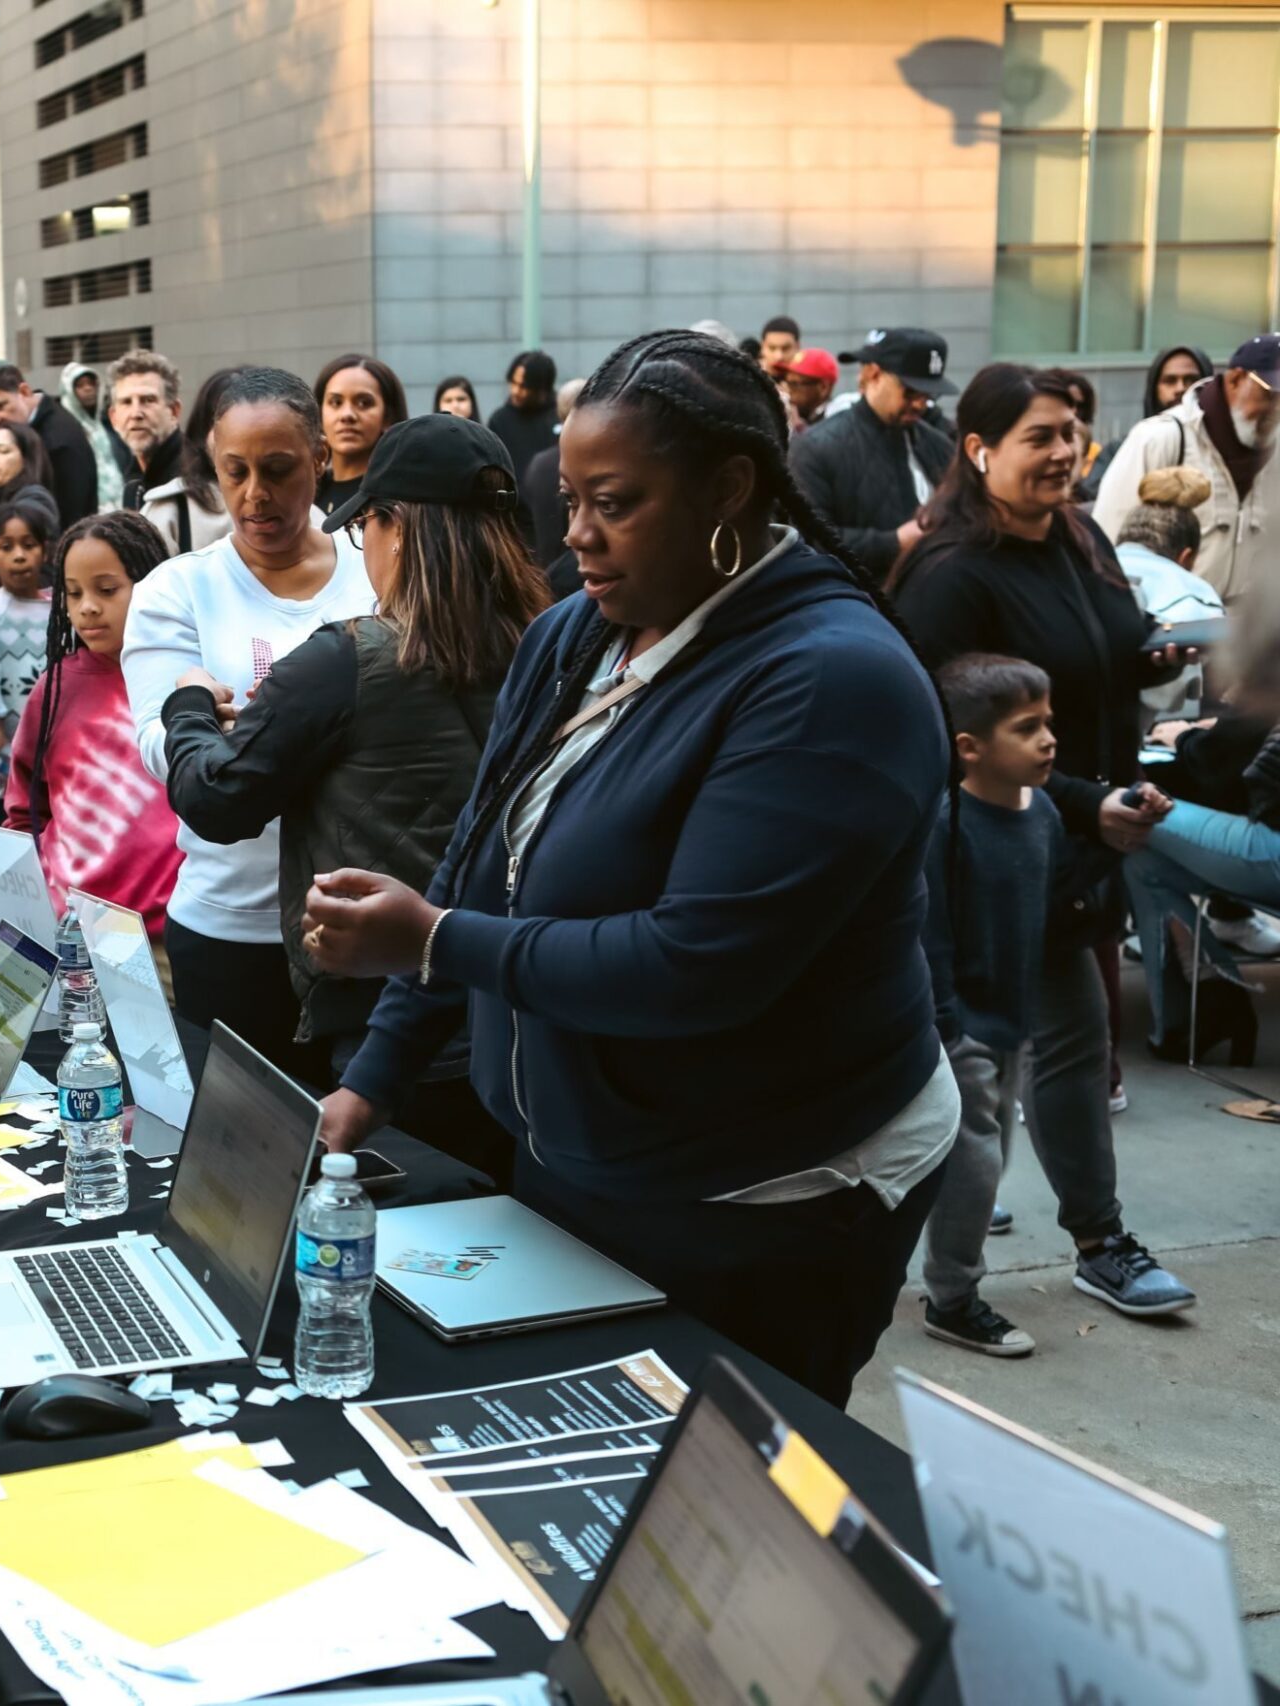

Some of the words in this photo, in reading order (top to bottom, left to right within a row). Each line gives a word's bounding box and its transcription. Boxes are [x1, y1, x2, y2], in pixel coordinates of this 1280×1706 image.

[70, 1089, 95, 1100] Pure
[73, 1099, 94, 1112] Life
[539, 1521, 592, 1573] Wildfires
